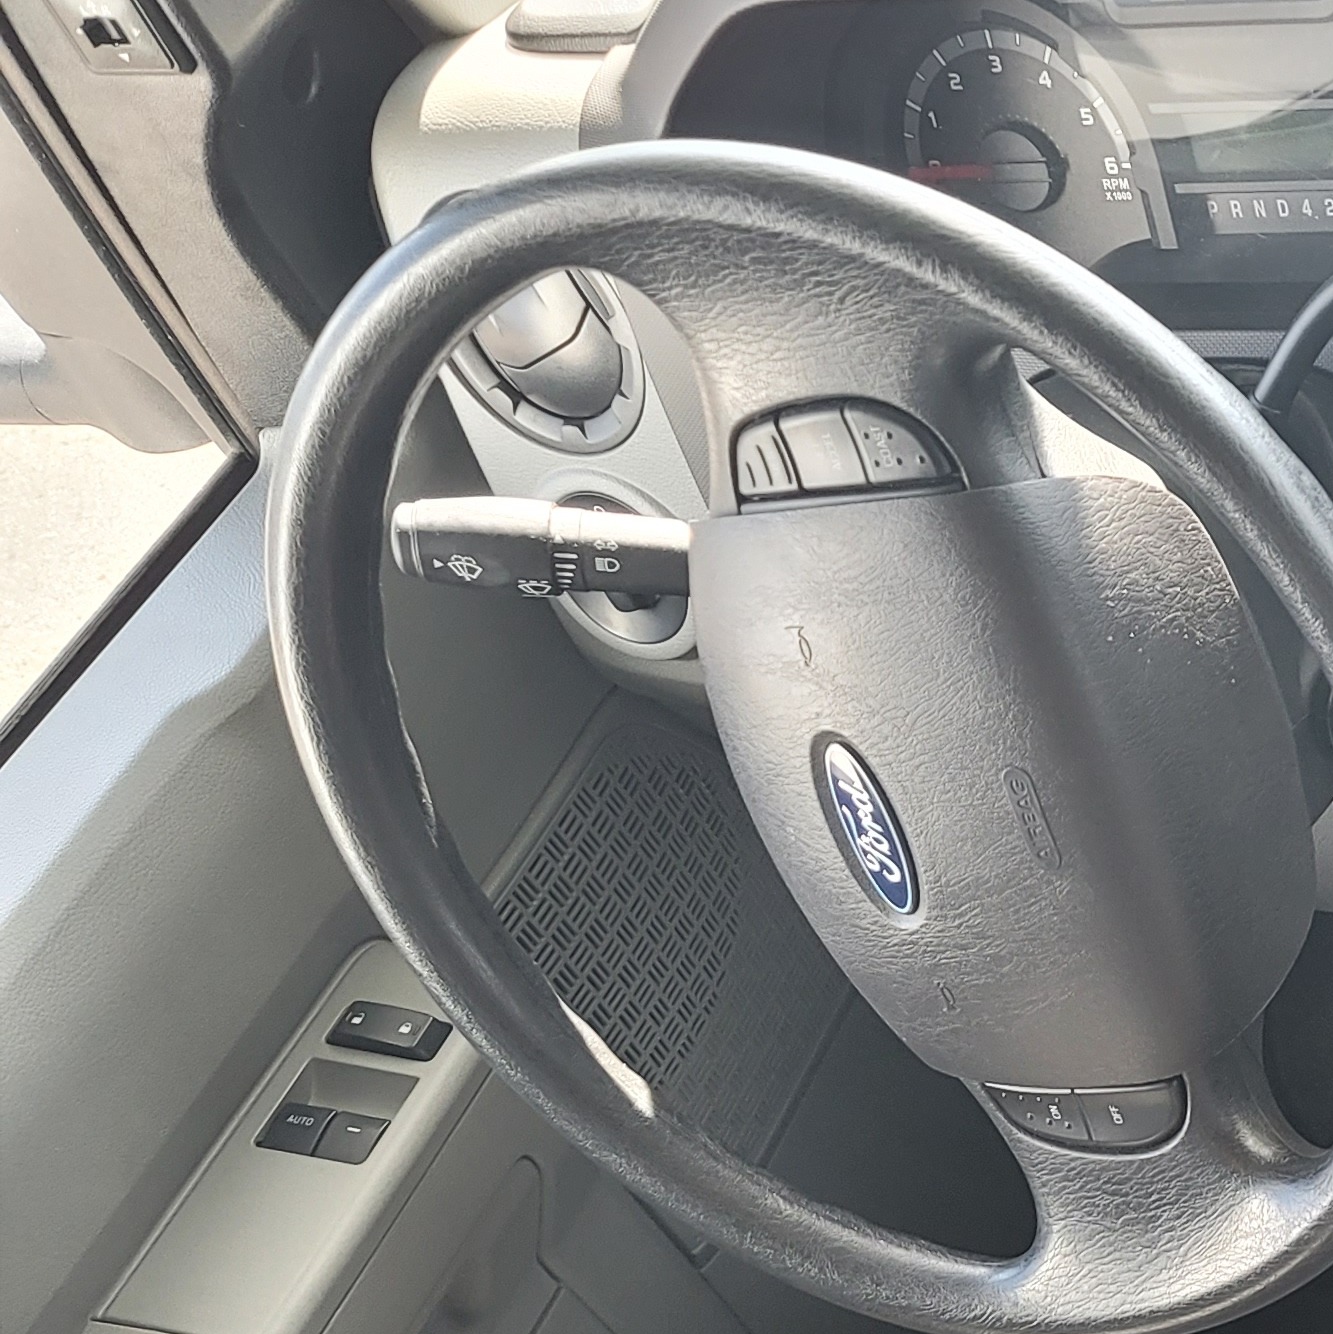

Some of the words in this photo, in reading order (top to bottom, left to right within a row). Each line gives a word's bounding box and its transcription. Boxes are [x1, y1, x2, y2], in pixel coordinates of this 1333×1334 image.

[988, 54, 1002, 73] 3
[948, 73, 963, 90] 2
[1038, 71, 1052, 88] 4
[928, 111, 938, 128] 1
[1080, 108, 1094, 126] 5
[1104, 157, 1119, 174] 6
[1102, 178, 1130, 191] RPM
[1105, 191, 1133, 201] X1000
[1229, 200, 1243, 218] R
[1253, 199, 1267, 218] N
[1276, 199, 1289, 217] D
[869, 424, 895, 469] COAST
[837, 778, 902, 883] Ford
[286, 1114, 315, 1127] AUTO
[1048, 1104, 1062, 1120] ON
[1108, 1104, 1124, 1125] OFF
